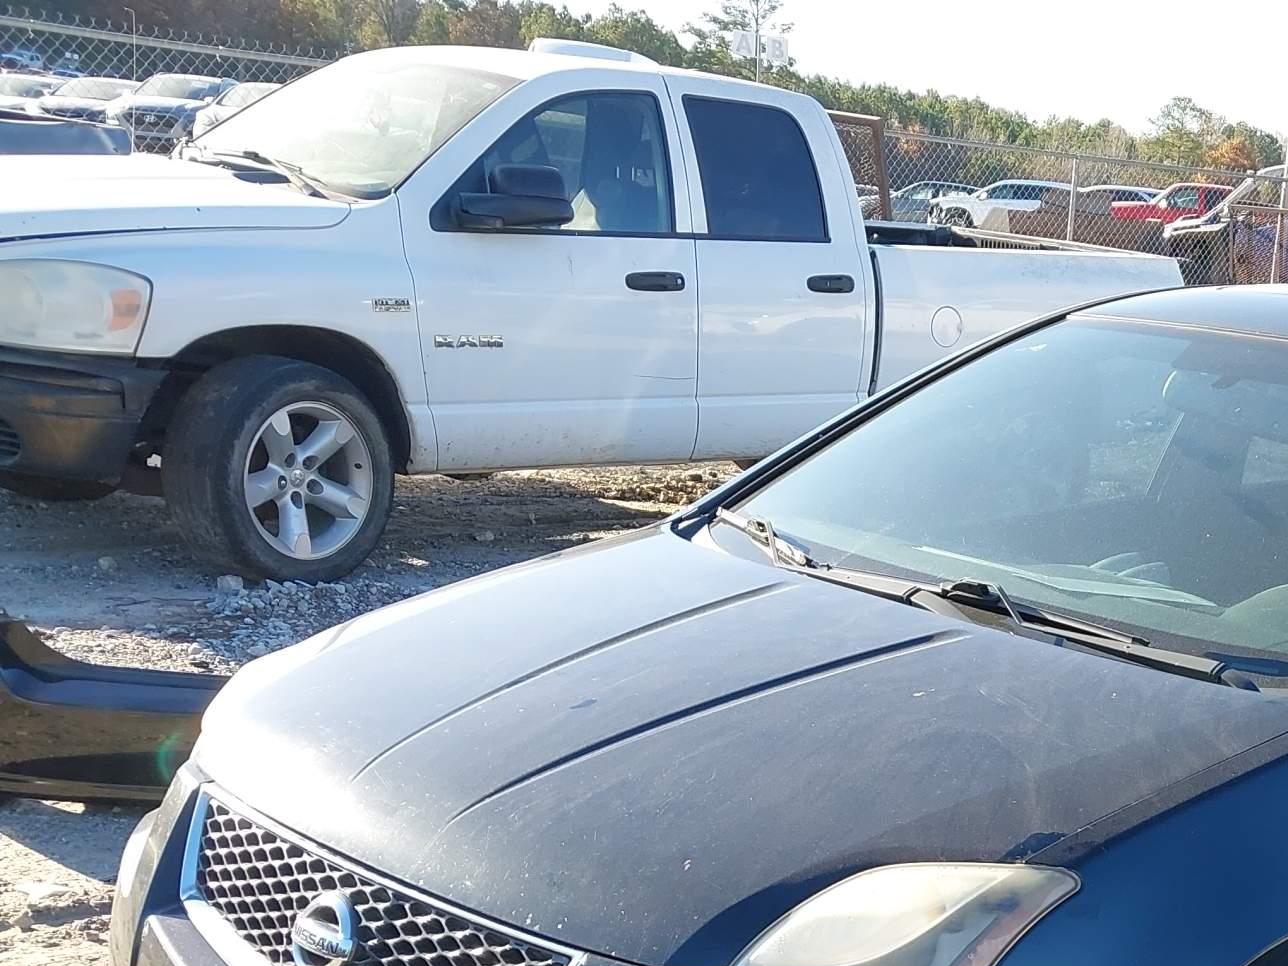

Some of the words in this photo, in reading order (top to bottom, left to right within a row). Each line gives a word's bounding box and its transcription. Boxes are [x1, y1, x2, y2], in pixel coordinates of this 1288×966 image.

[736, 33, 752, 55] A
[772, 39, 784, 58] B
[434, 334, 504, 348] RAM
[294, 924, 339, 955] NISSAN
